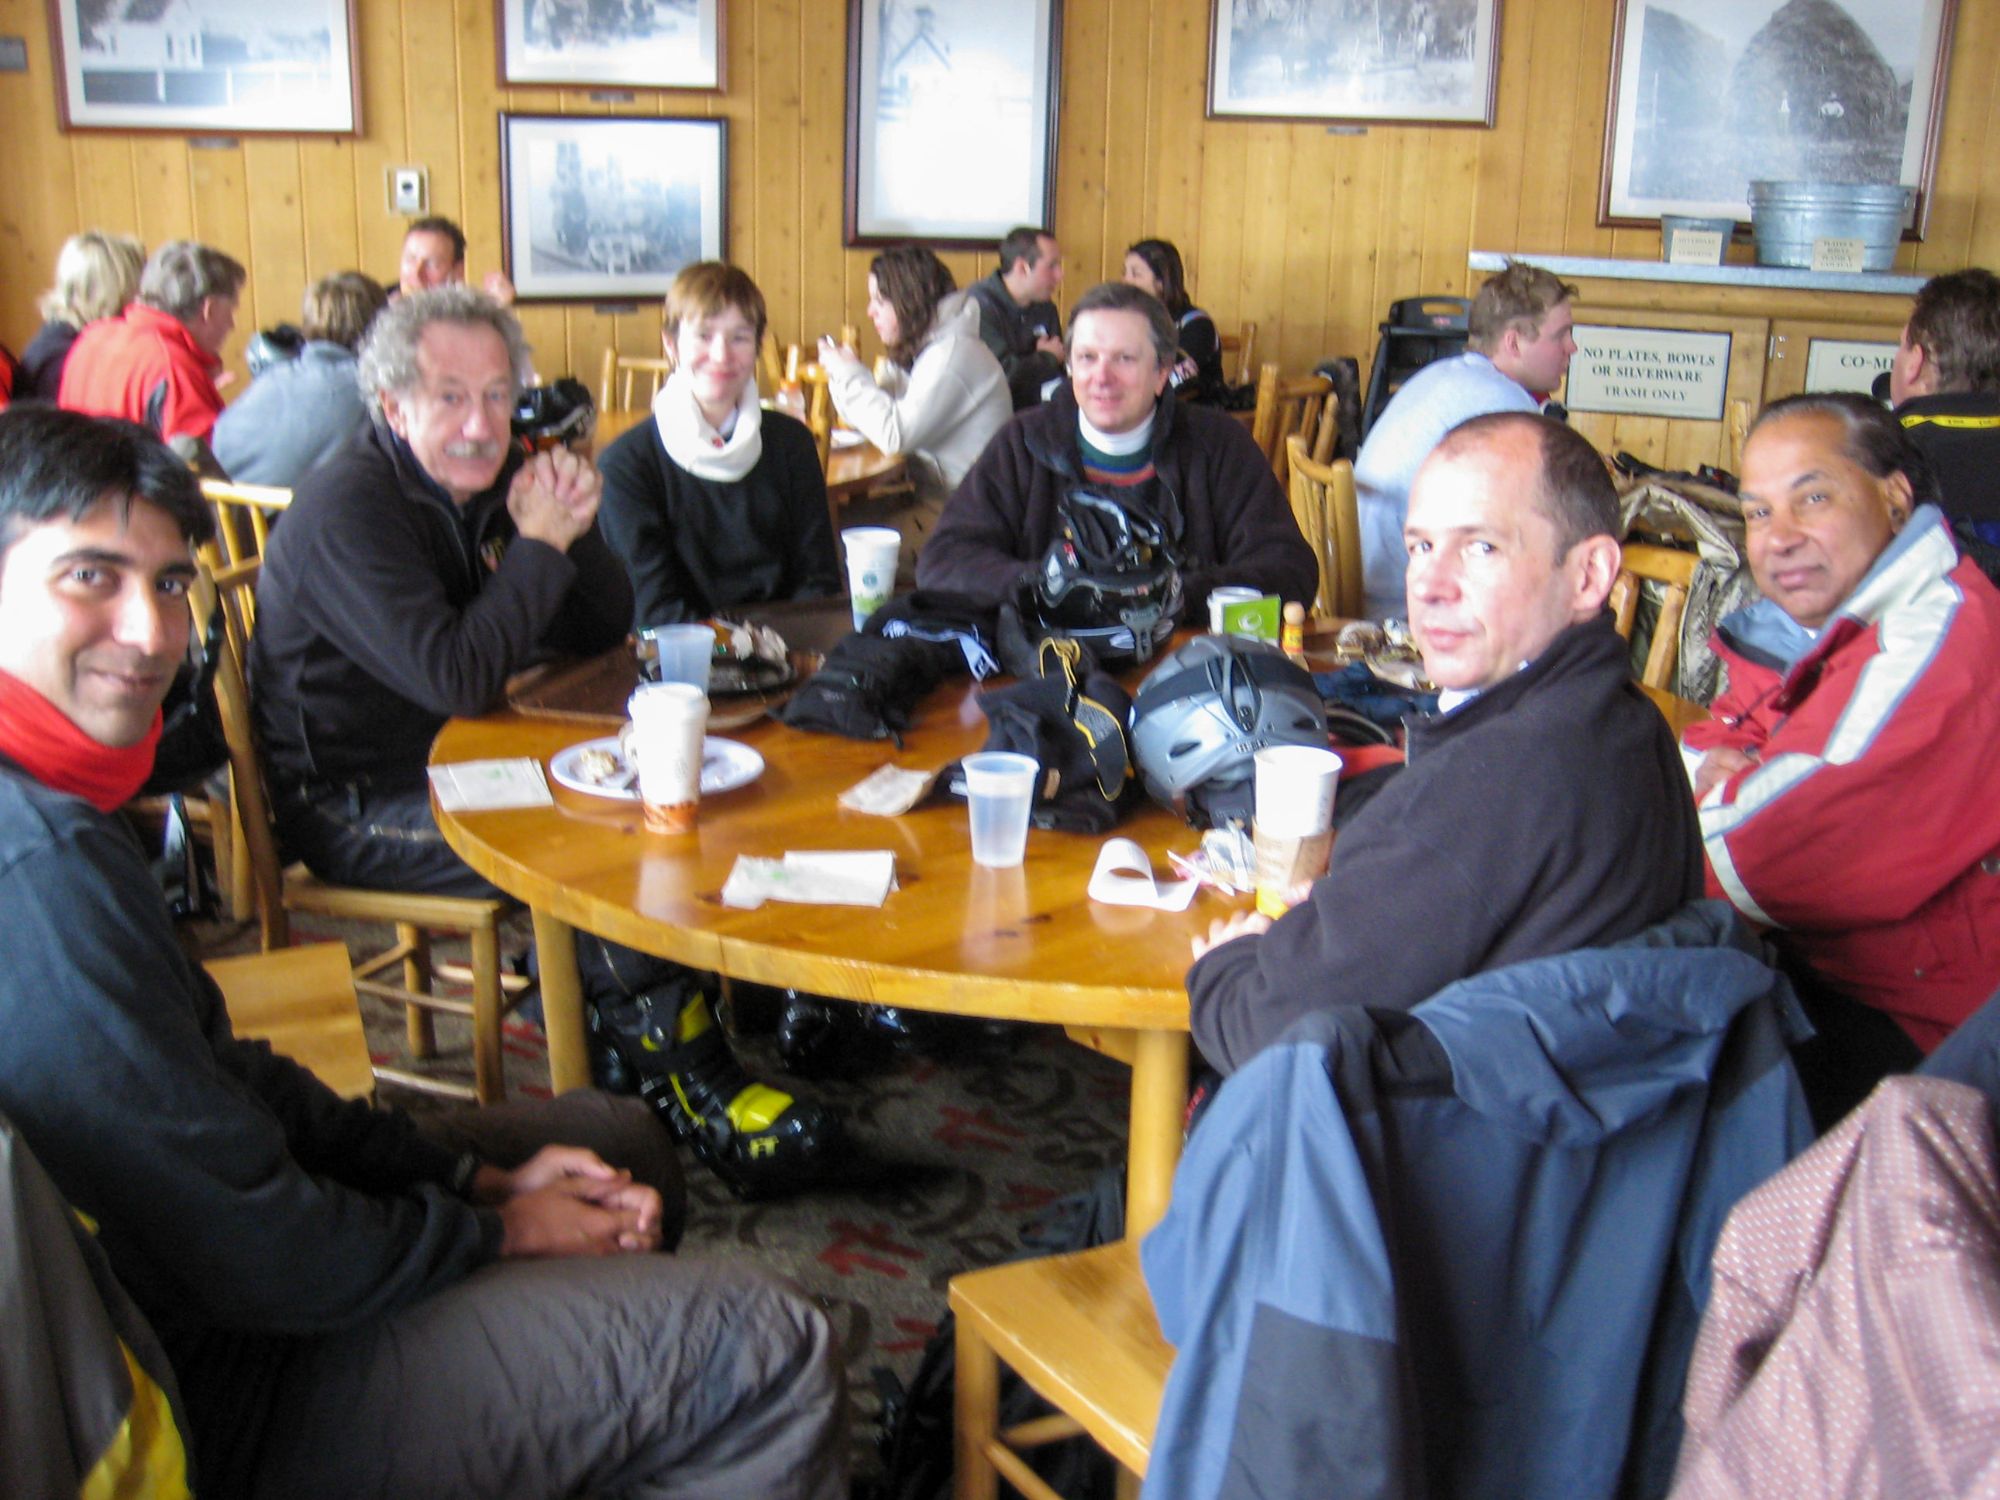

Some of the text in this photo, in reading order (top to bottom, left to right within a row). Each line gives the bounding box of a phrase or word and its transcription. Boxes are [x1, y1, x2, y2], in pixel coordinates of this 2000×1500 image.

[1584, 347, 1716, 366] NO PLATES, BOWLS
[1592, 365, 1703, 383] OR SILVERWARE
[1604, 385, 1689, 401] TRASH ONLY
